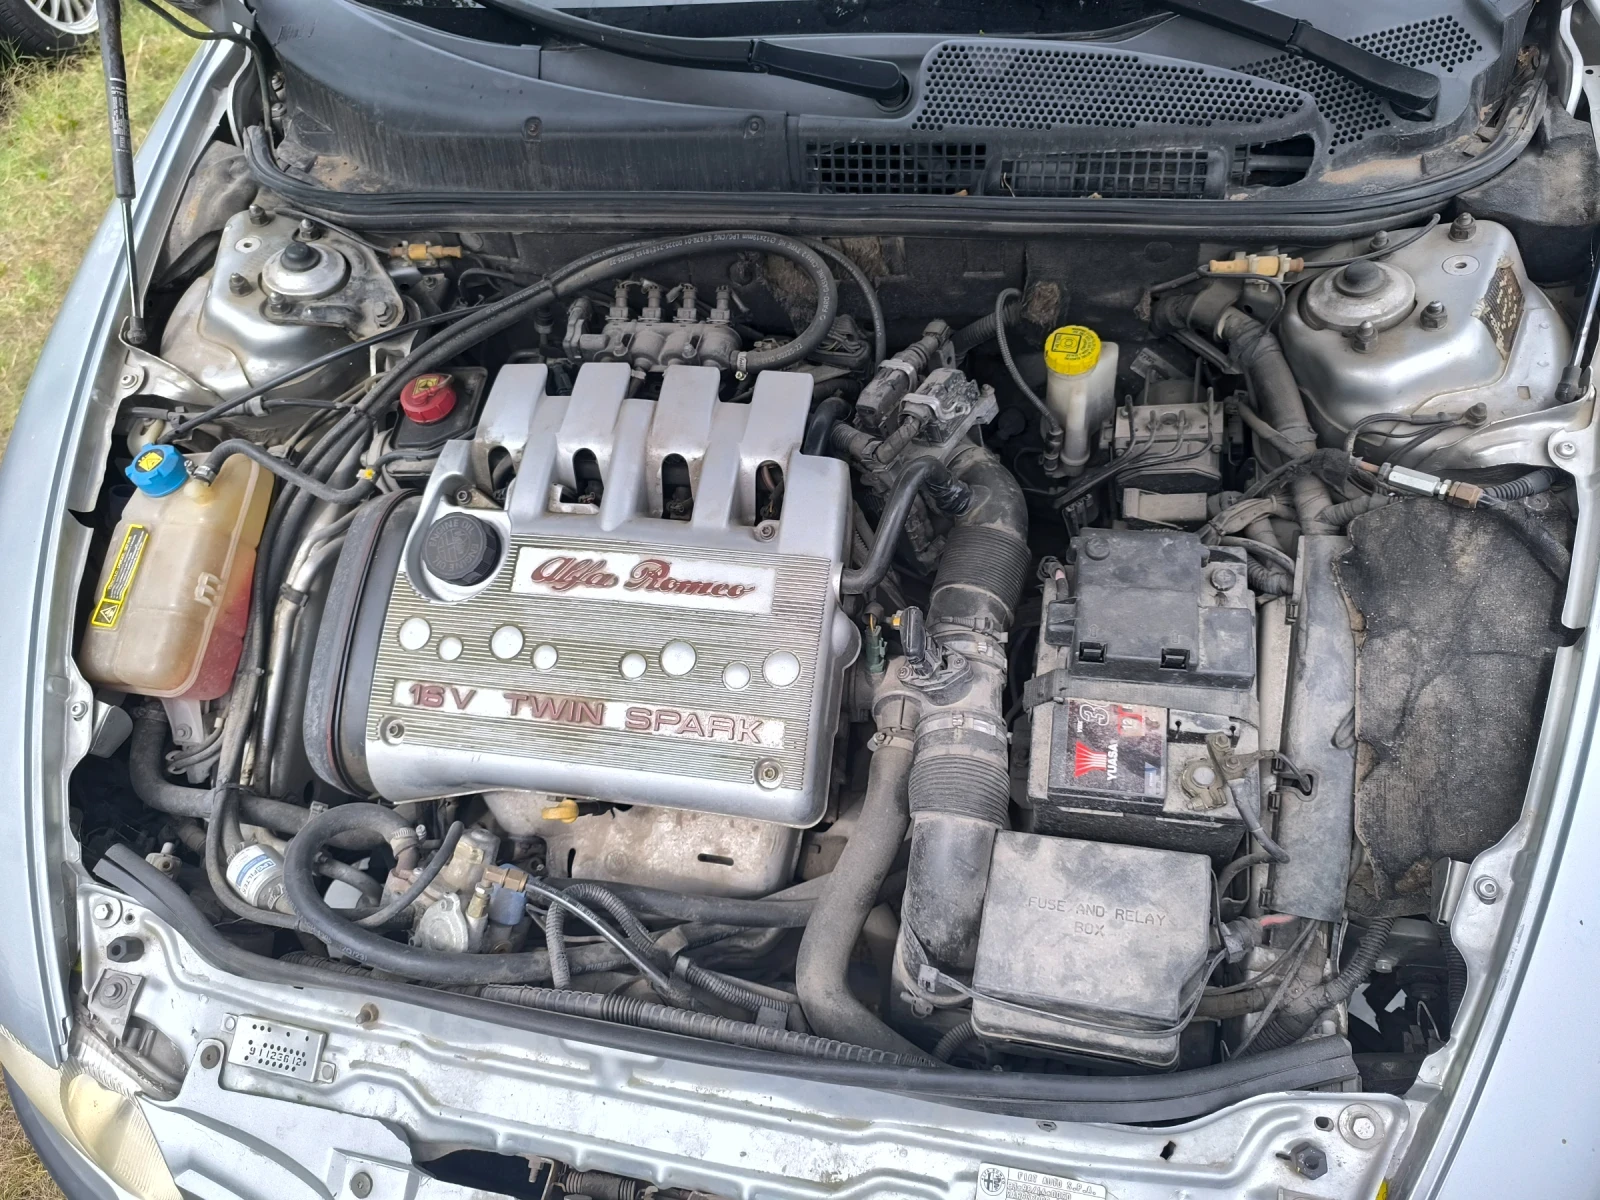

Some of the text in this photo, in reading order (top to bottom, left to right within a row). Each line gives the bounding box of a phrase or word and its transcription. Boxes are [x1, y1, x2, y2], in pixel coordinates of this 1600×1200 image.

[429, 519, 476, 546] ENGINE OIL
[449, 544, 479, 572] ENGINE
[530, 556, 756, 598] Alfa Romeo
[504, 692, 604, 726] TWIN
[624, 706, 764, 745] SPARK
[1106, 743, 1118, 780] YUASA
[242, 870, 258, 894] FILTER
[1028, 896, 1166, 926] FUSE AND RELAY
[1074, 921, 1104, 937] BOX
[1018, 1172, 1096, 1196] FIAT AUTO S.P.A.
